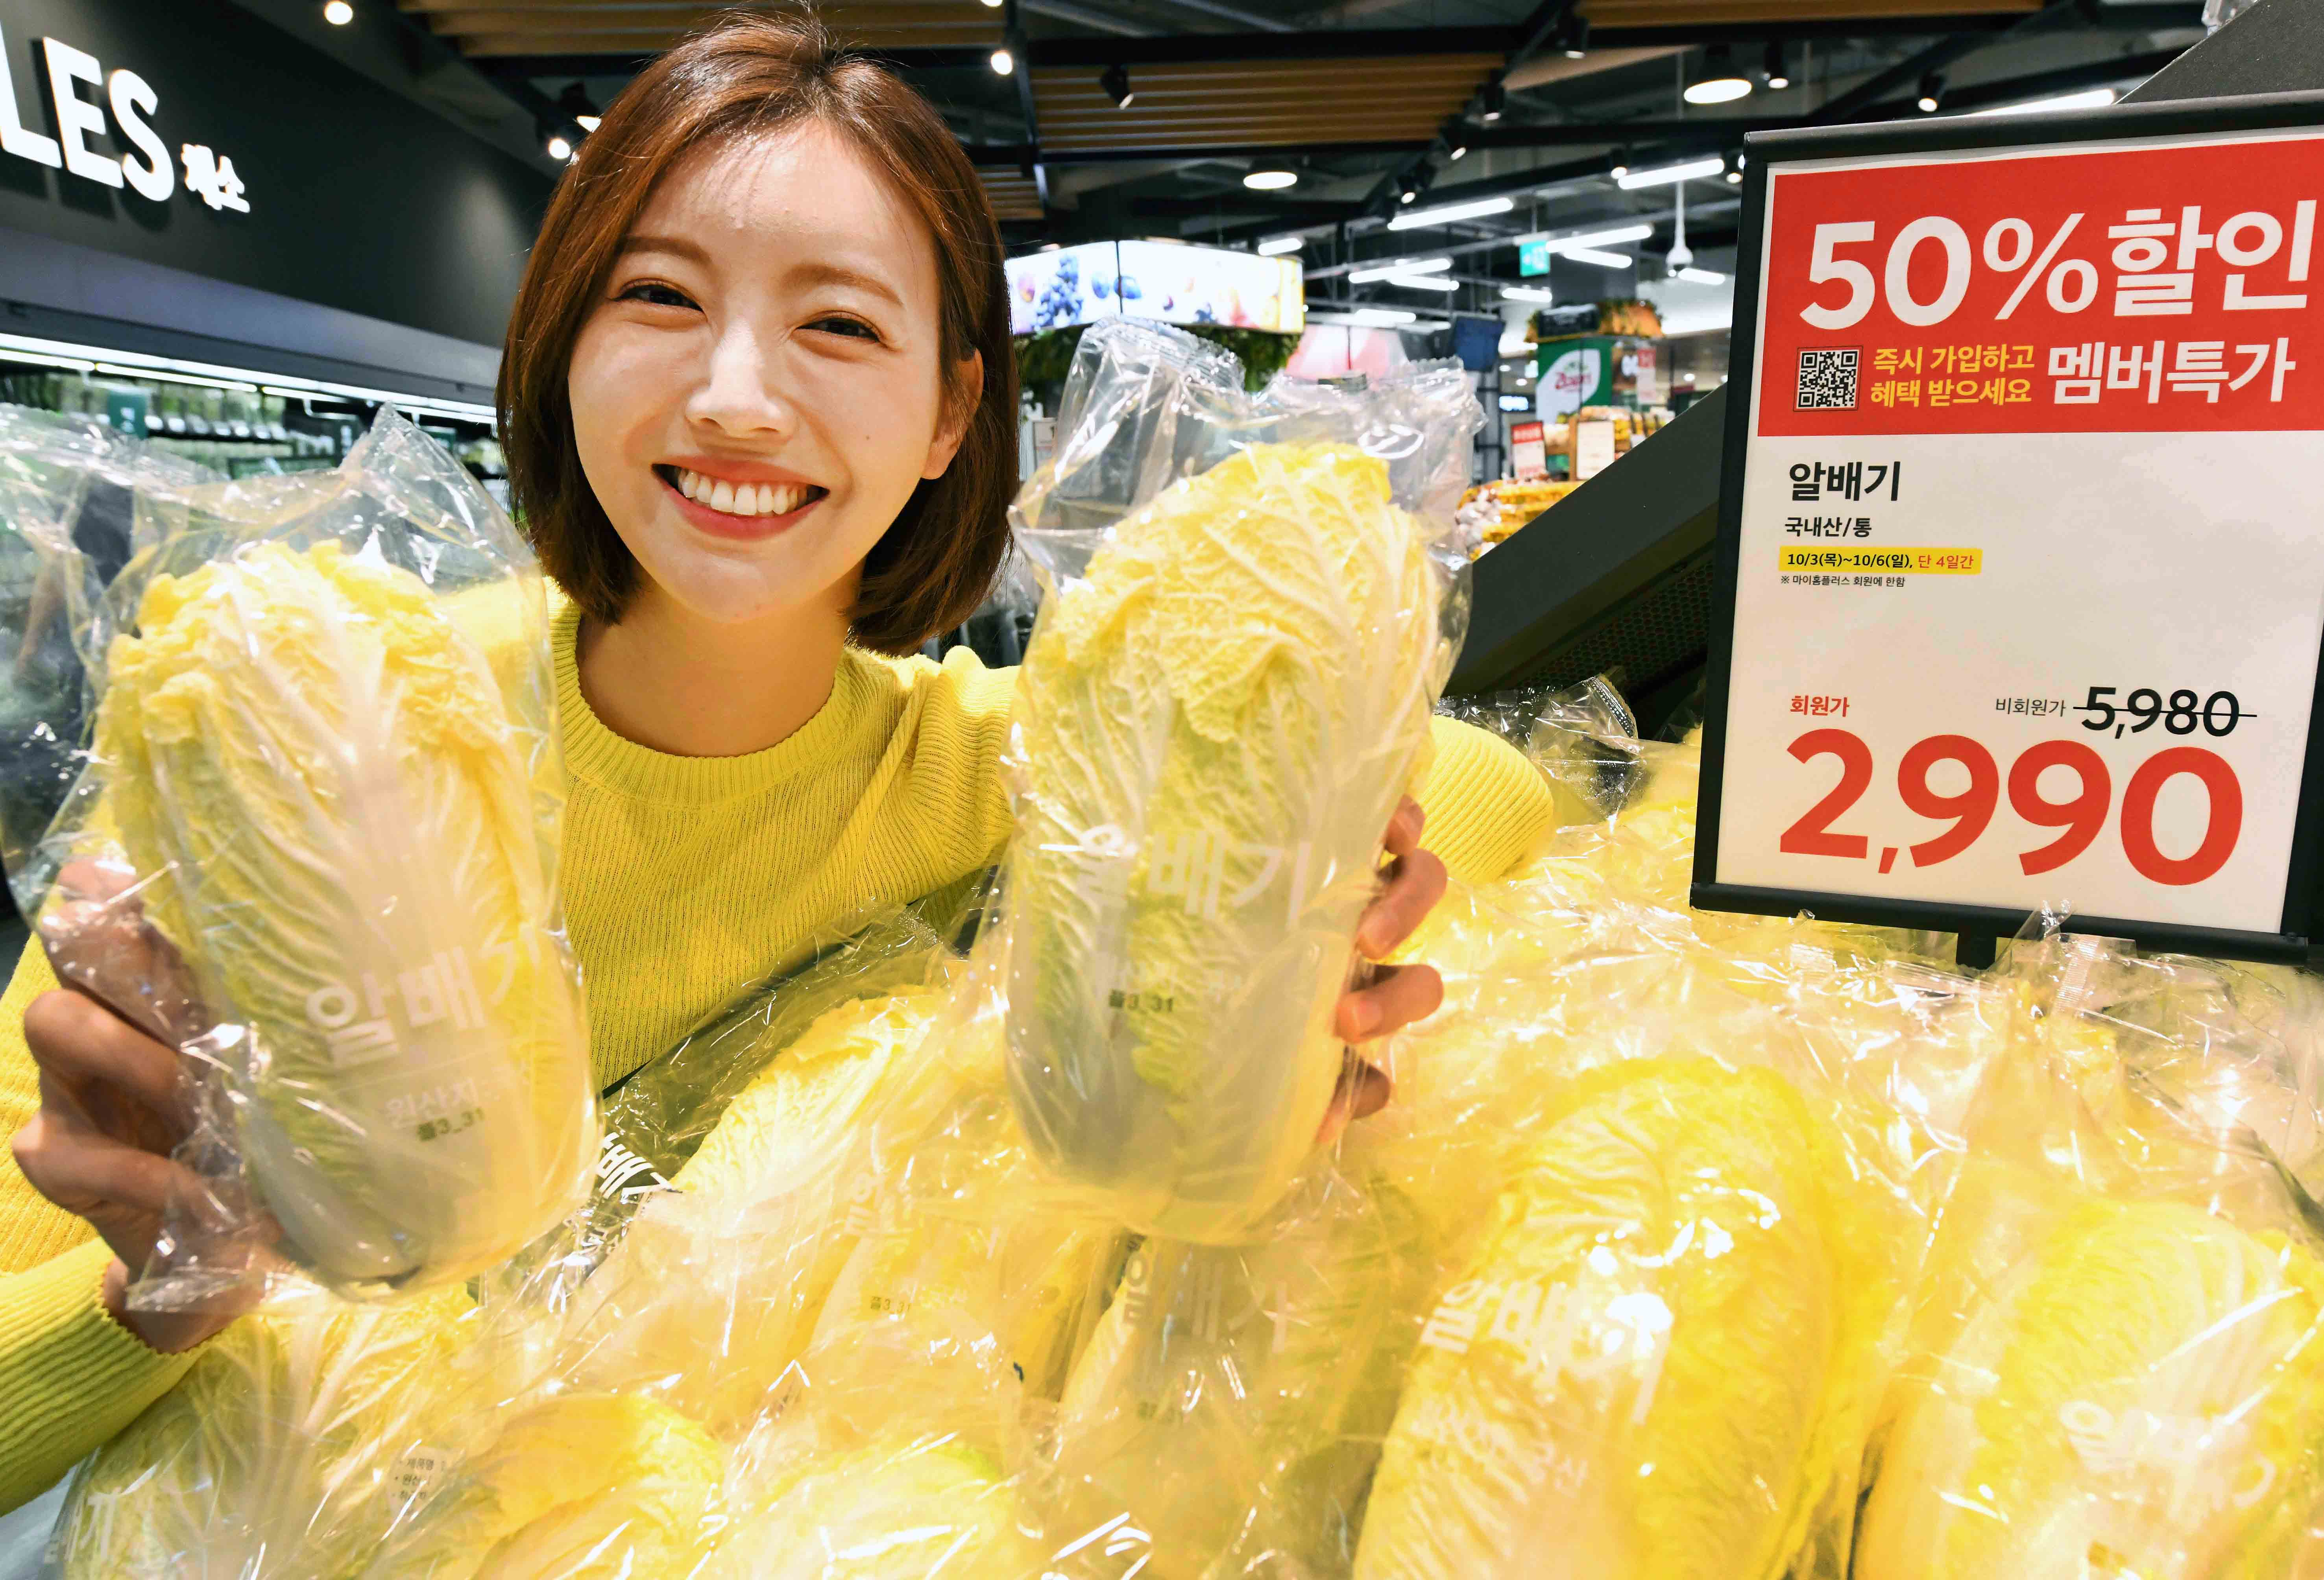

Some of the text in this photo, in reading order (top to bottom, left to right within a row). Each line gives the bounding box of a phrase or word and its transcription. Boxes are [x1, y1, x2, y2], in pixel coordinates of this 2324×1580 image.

[1873, 343, 2035, 375] 즉시 가입하고
[2048, 337, 2296, 404] 멤버특가
[1870, 377, 2032, 408] 혜택 받으세요
[1789, 461, 1901, 502] 알배기
[1784, 516, 1872, 538] 국내산/통
[1918, 554, 1932, 569] 단
[1936, 555, 1974, 569] 4일간
[1792, 574, 1850, 586] 마이홈플러스
[1853, 576, 1882, 587] 회원에
[1886, 576, 1905, 587] 한함
[1790, 695, 1850, 718] 회원가
[1995, 697, 2067, 718] 비회원가
[2081, 686, 2240, 740] 5,980
[1779, 728, 2243, 886] 2,990
